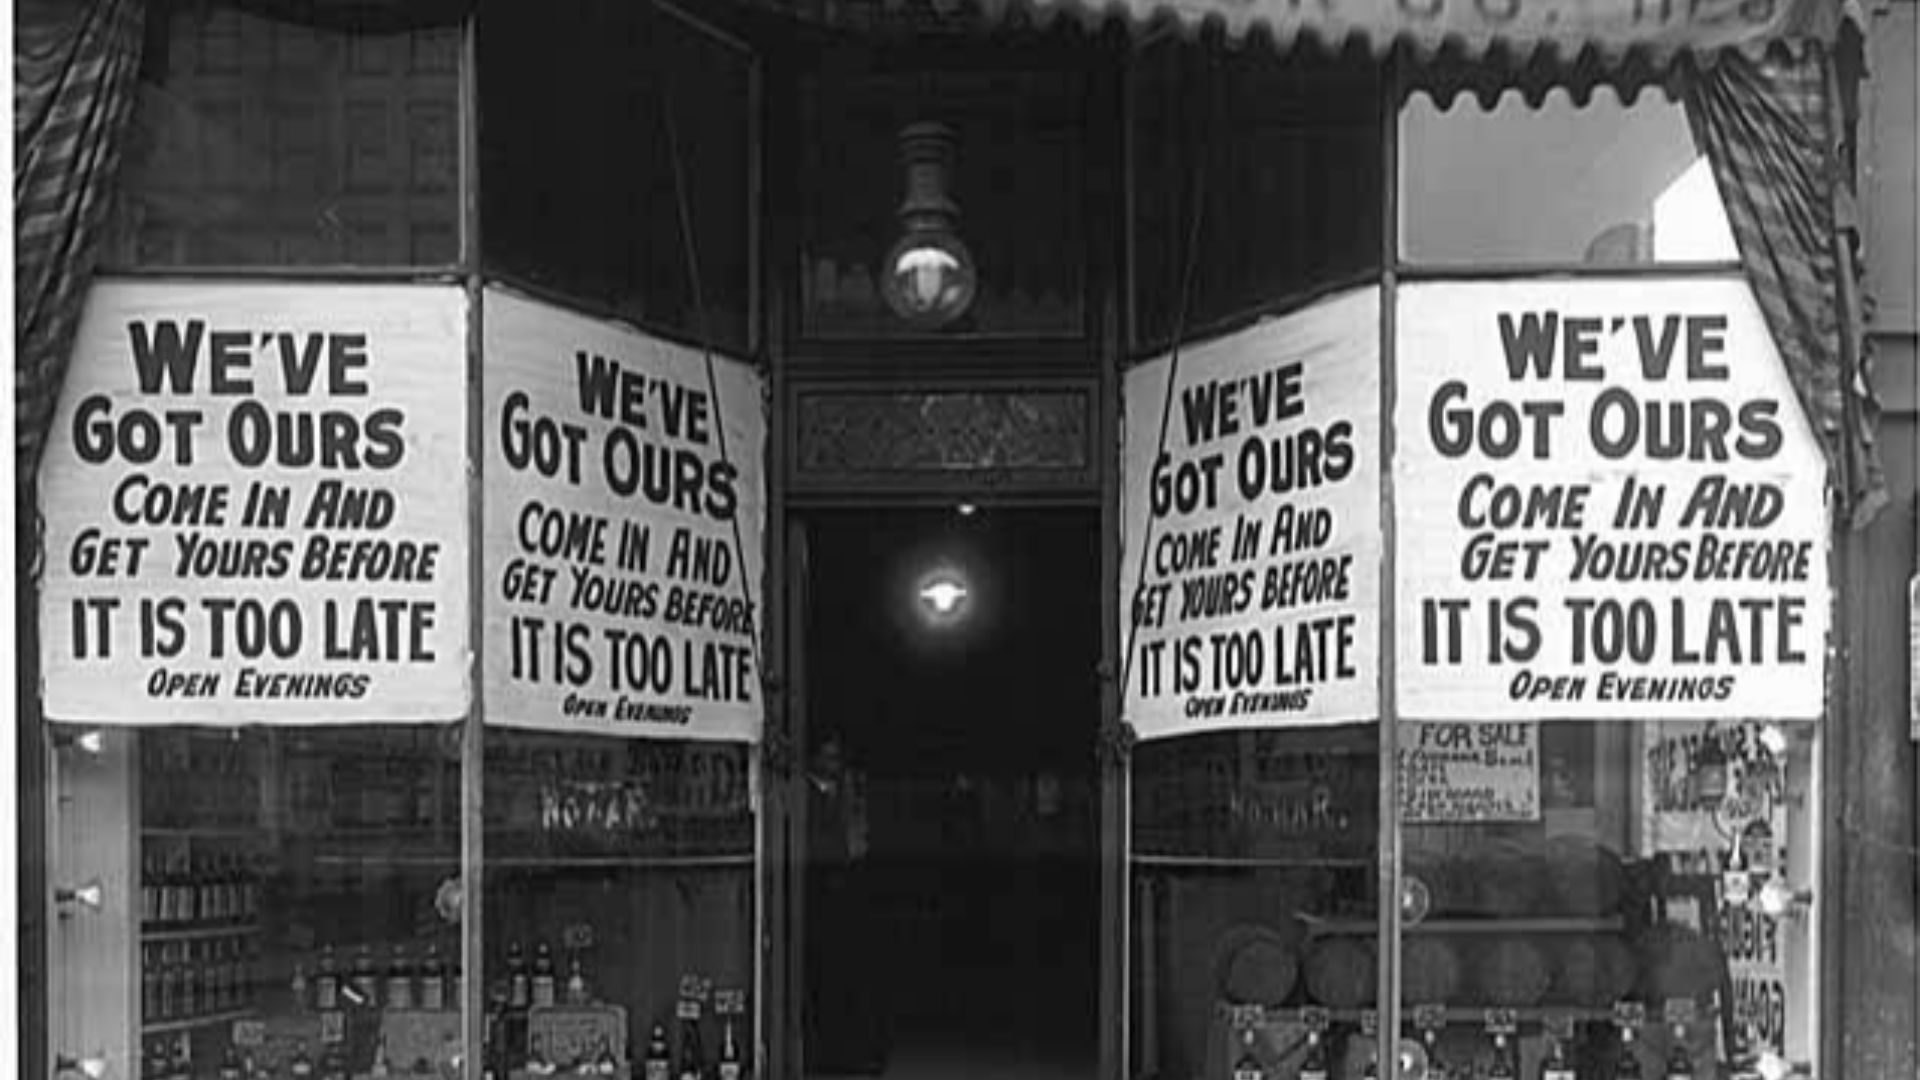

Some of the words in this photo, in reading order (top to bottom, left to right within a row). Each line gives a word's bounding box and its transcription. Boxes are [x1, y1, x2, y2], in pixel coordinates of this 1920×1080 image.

[128, 319, 369, 396] WE'VE
[1498, 311, 1729, 381] WE'VE
[72, 394, 202, 465] GOT
[227, 399, 405, 469] OURS
[576, 350, 708, 445] WE'VE
[1183, 362, 1304, 445] WE'VE
[1429, 381, 1564, 459] GOT
[1588, 387, 1783, 461] OURS
[501, 391, 587, 484] GOT
[603, 427, 738, 520] OURS
[1150, 451, 1223, 517] GOT
[1237, 421, 1354, 500] OURS
[112, 473, 229, 525] COME
[241, 481, 291, 528] IN
[303, 479, 395, 531] AND
[1457, 473, 1591, 528] COME
[1612, 474, 1666, 529] IN
[1678, 474, 1783, 529] AND
[69, 528, 149, 576] GET
[174, 532, 294, 578] YOURS
[300, 534, 439, 582] BEFORE
[518, 501, 608, 565] COME
[618, 519, 650, 572] IN
[666, 528, 731, 586] AND
[1155, 526, 1222, 577] COME
[1231, 514, 1262, 562] IN
[1270, 504, 1332, 556] AND
[1460, 533, 1550, 581] GET
[1568, 534, 1691, 582] YOURS
[1693, 534, 1812, 582] BEFORE
[502, 559, 556, 604] GET
[570, 567, 659, 618] YOURS
[663, 587, 756, 635] BEFORE
[1180, 571, 1255, 622] YOURS
[1261, 556, 1352, 610] BEFORE
[72, 598, 120, 659] IT
[141, 597, 185, 658] IS
[201, 597, 302, 659] TOO
[324, 599, 435, 661] LATE
[512, 617, 544, 682] IT
[554, 622, 593, 686] IS
[603, 629, 672, 694] TOO
[684, 640, 751, 702] LATE
[1140, 640, 1165, 697] IT
[1174, 636, 1201, 694] IS
[1210, 629, 1264, 691] TOO
[1274, 616, 1356, 686] LATE
[1422, 598, 1471, 664] IT
[1488, 597, 1542, 665] IS
[1564, 597, 1657, 665] TOO
[1672, 597, 1806, 665] LATE
[147, 668, 220, 696] OPEN
[234, 668, 371, 699] EVENINGS
[1509, 670, 1586, 700] OPEN
[1597, 671, 1735, 701] EVENINGS
[1420, 723, 1472, 748] FOR
[1478, 723, 1526, 746] SALE
